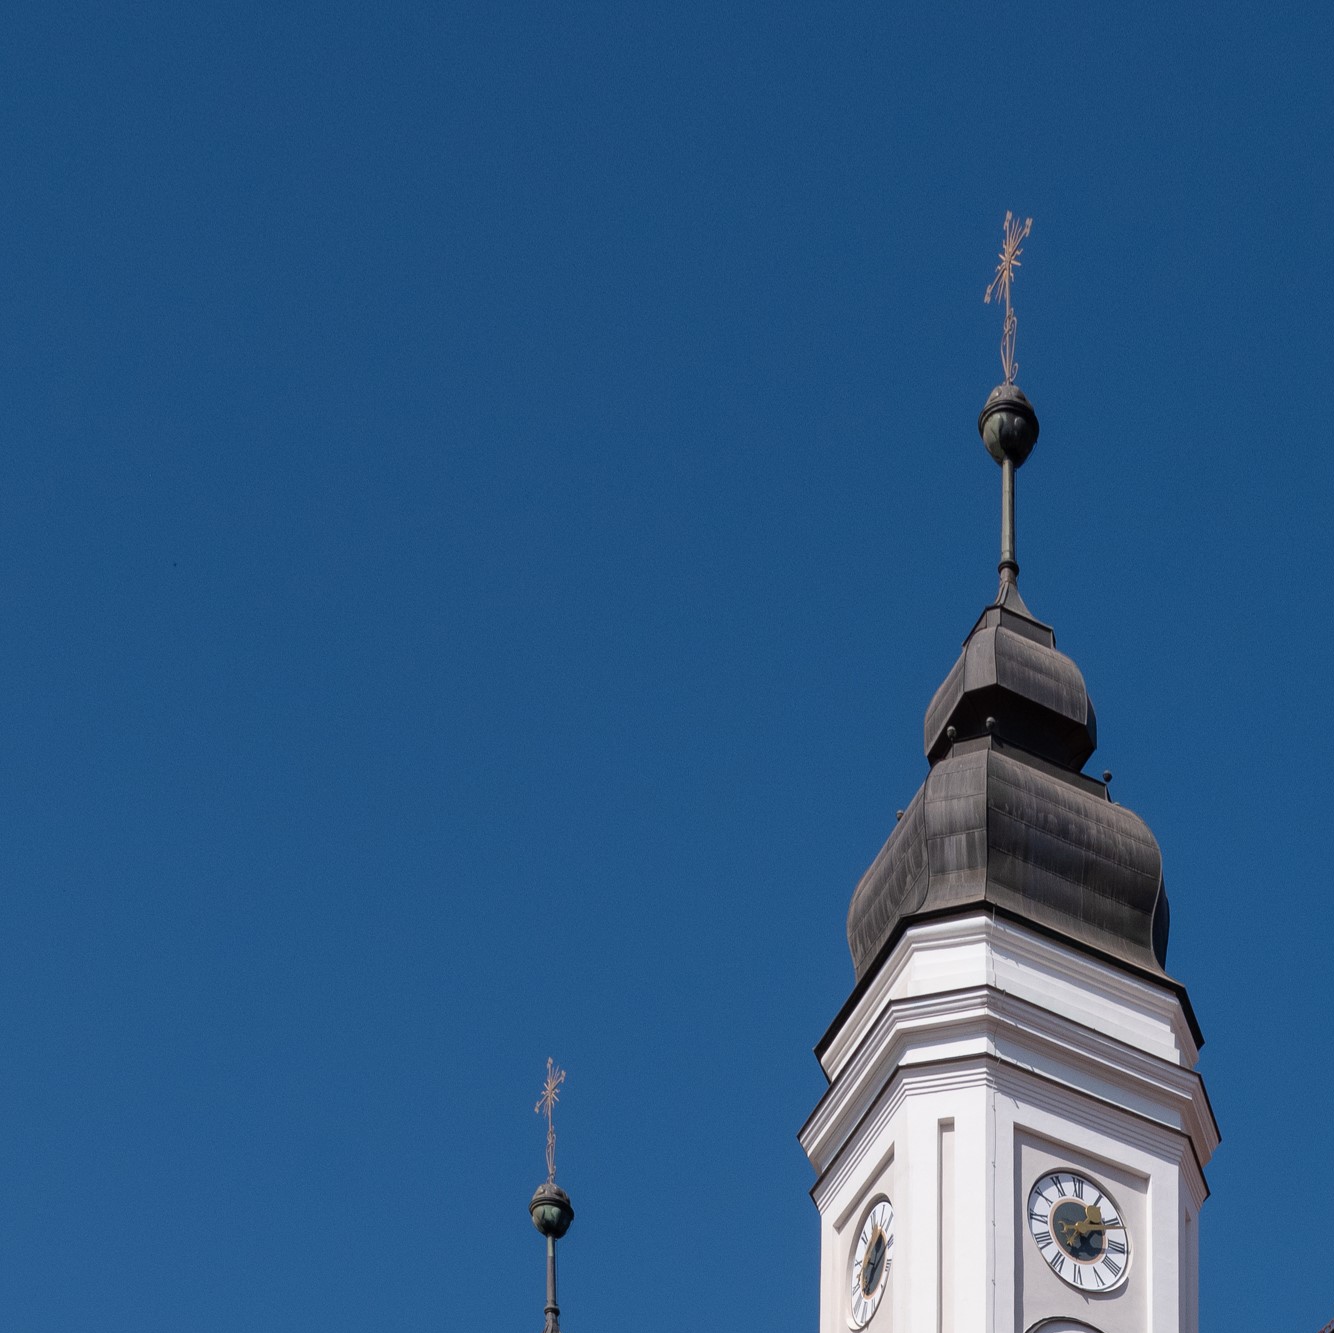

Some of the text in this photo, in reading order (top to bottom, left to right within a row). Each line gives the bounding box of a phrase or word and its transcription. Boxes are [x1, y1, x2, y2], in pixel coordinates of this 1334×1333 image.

[1034, 1186, 1053, 1207] X
[1072, 1176, 1084, 1200] XII
[1108, 1239, 1126, 1255] III
[1073, 1264, 1083, 1286] VI
[1093, 1266, 1106, 1288] V
